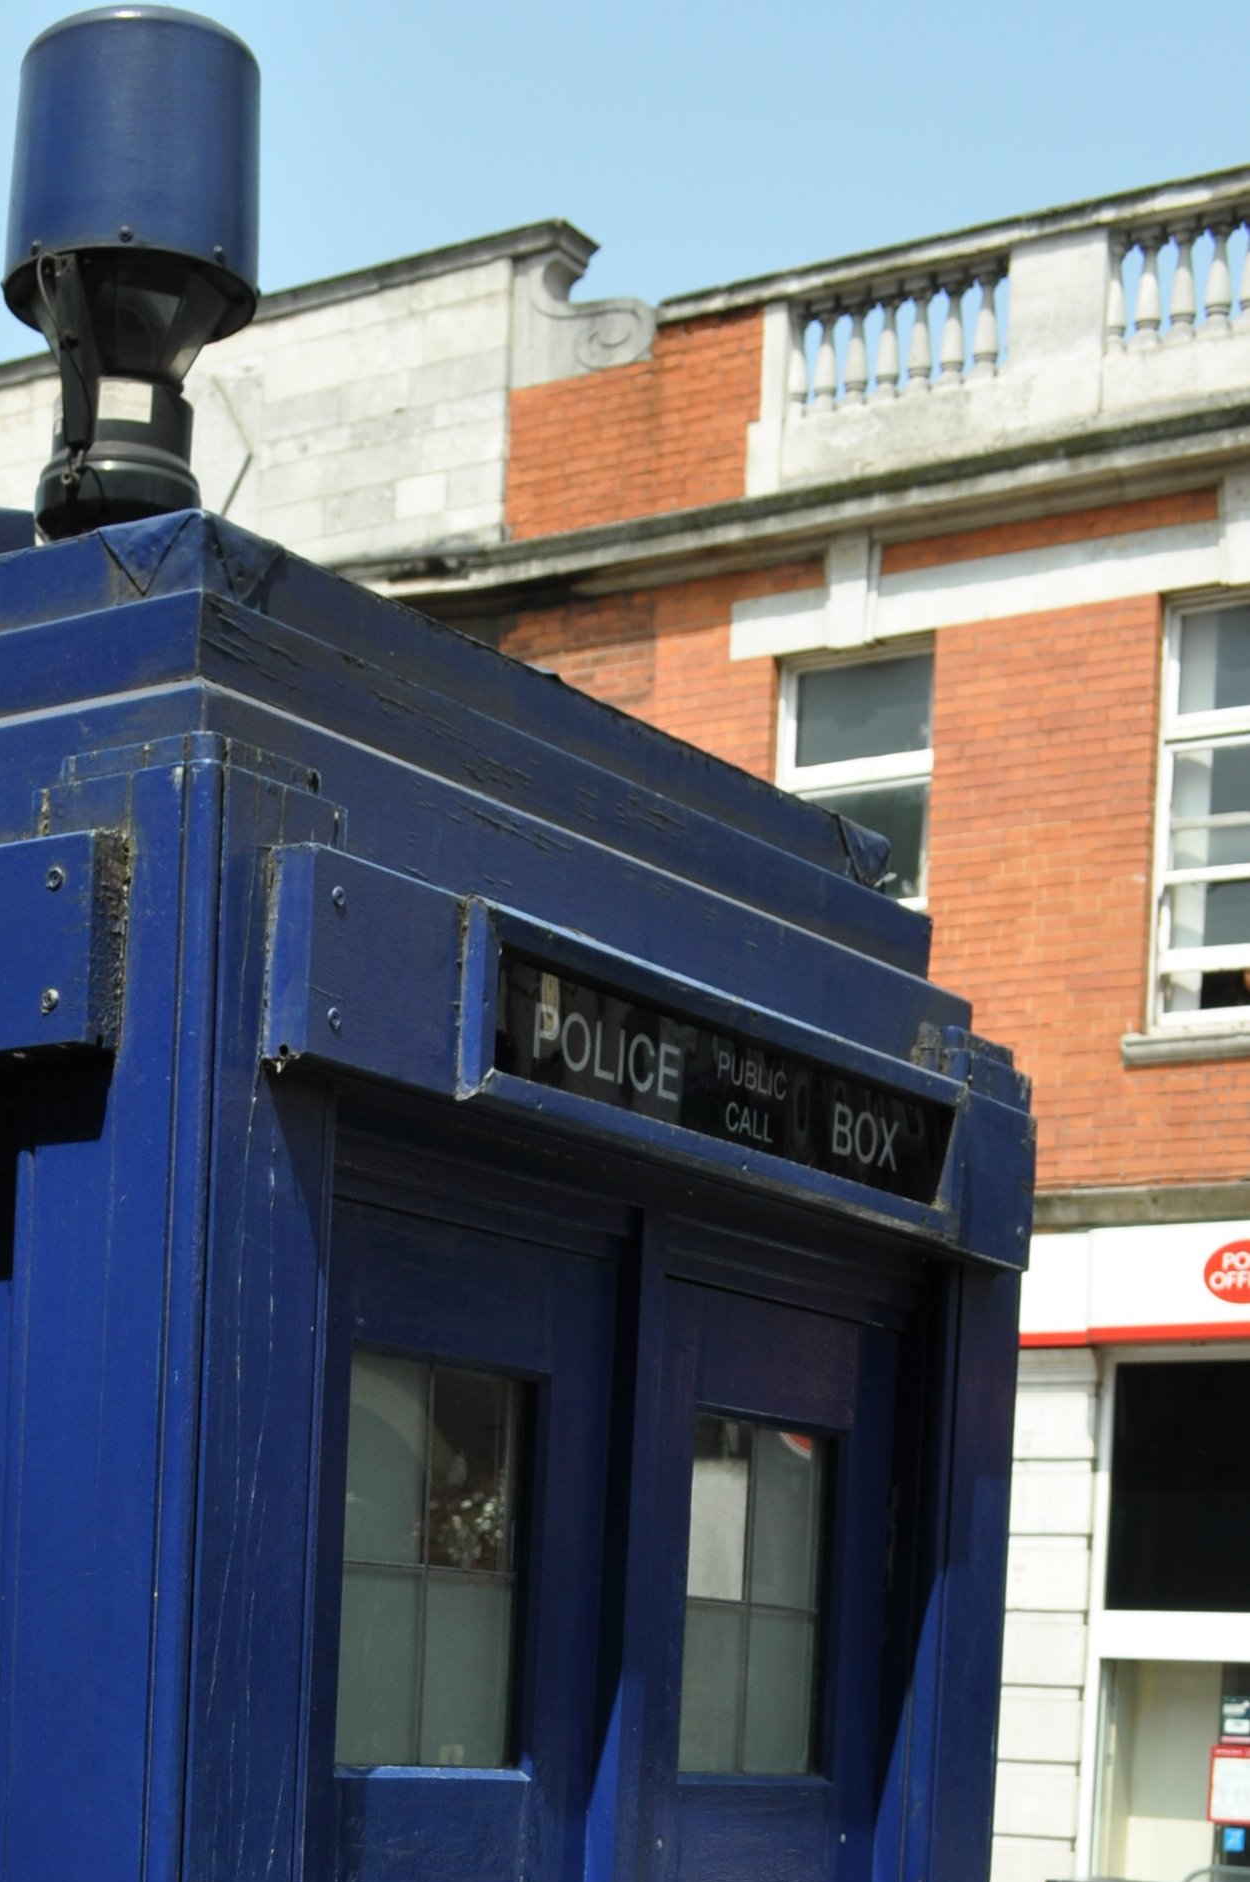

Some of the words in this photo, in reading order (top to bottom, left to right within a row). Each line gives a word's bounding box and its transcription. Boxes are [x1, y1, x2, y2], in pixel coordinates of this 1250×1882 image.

[533, 1002, 682, 1101] POLICE
[716, 1051, 789, 1100] PUBLIC
[724, 1101, 774, 1144] CALL
[831, 1102, 900, 1172] BOX
[1208, 1270, 1250, 1291] OFF
[1220, 1249, 1250, 1271] PO
